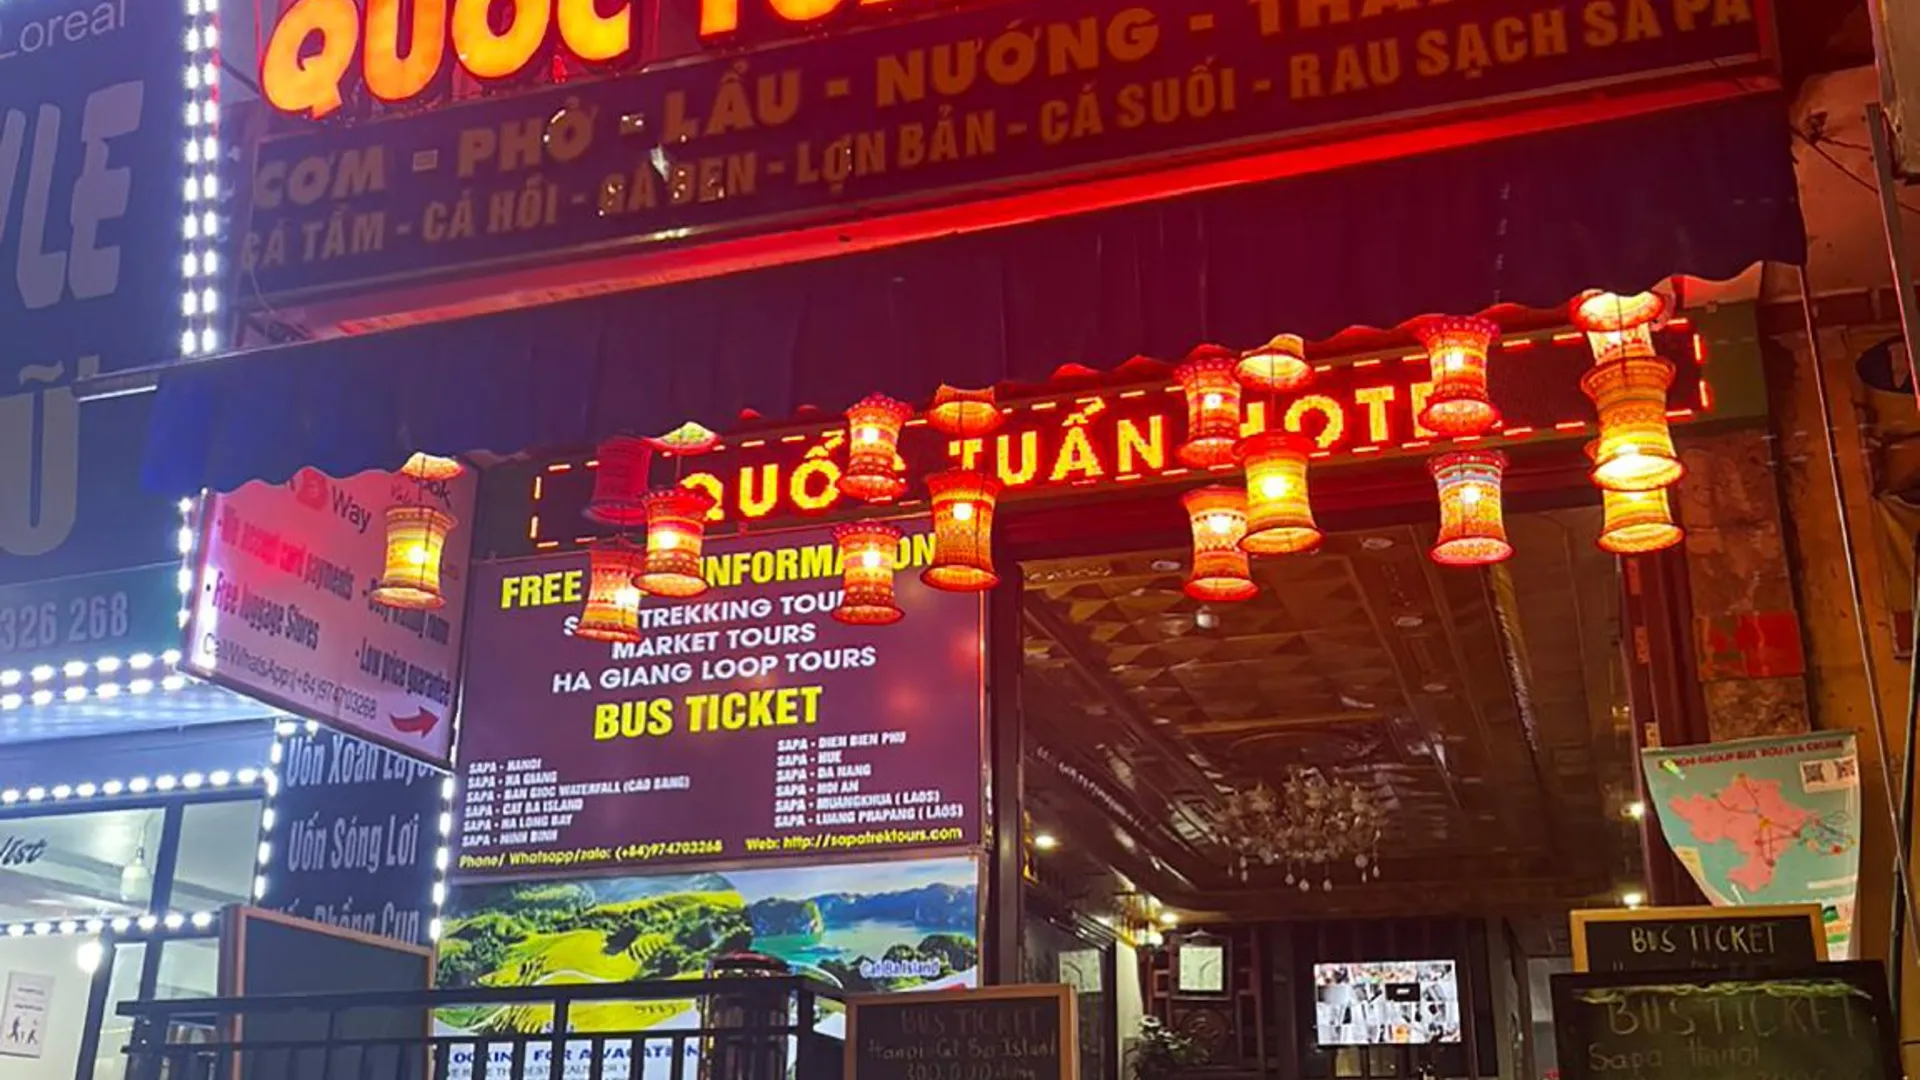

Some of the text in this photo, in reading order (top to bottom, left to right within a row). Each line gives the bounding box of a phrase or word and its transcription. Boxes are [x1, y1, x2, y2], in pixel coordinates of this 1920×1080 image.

[876, 6, 1160, 109] NƯỚNG
[1041, 82, 1103, 146] CÁ
[1116, 54, 1237, 130] SUỐI
[1290, 38, 1401, 99] RAU
[1416, 9, 1568, 79] SẠCH
[1583, 0, 1662, 47] SA
[331, 485, 373, 534] Way
[501, 569, 583, 608] FREE
[0, 591, 128, 651] 326 268
[640, 598, 772, 629] TREKKING
[612, 622, 817, 660] MARKET TOURS
[553, 645, 877, 693] HA GIANG LOOP TOURS
[594, 685, 823, 740] BUS TICKET
[778, 738, 808, 752] SAPA
[818, 735, 848, 749] DIEN
[469, 758, 542, 774] SAPA HANOI
[776, 769, 807, 782] SAPA
[837, 763, 871, 777] NANG
[777, 754, 808, 767] SAPA
[466, 790, 494, 803] SAPA
[559, 781, 621, 797] WATERFALL
[468, 771, 558, 788] SAPA HA GIANG
[775, 784, 807, 797] SAPA
[465, 798, 584, 817] SAPA CAT BA ISLAND
[774, 799, 806, 813] SAPA
[774, 815, 805, 828] SAPA
[816, 809, 855, 825] LUANG
[463, 813, 573, 832] SAPA HA LONG BAY
[287, 811, 327, 872] Uốn
[331, 815, 382, 874] Sóng
[462, 833, 491, 847] SAPA
[746, 838, 780, 851] Web:
[1631, 923, 1779, 954] BUS TICKET
[1606, 995, 1857, 1038] BUS TICKET
[1588, 1042, 1662, 1071] Sapa
